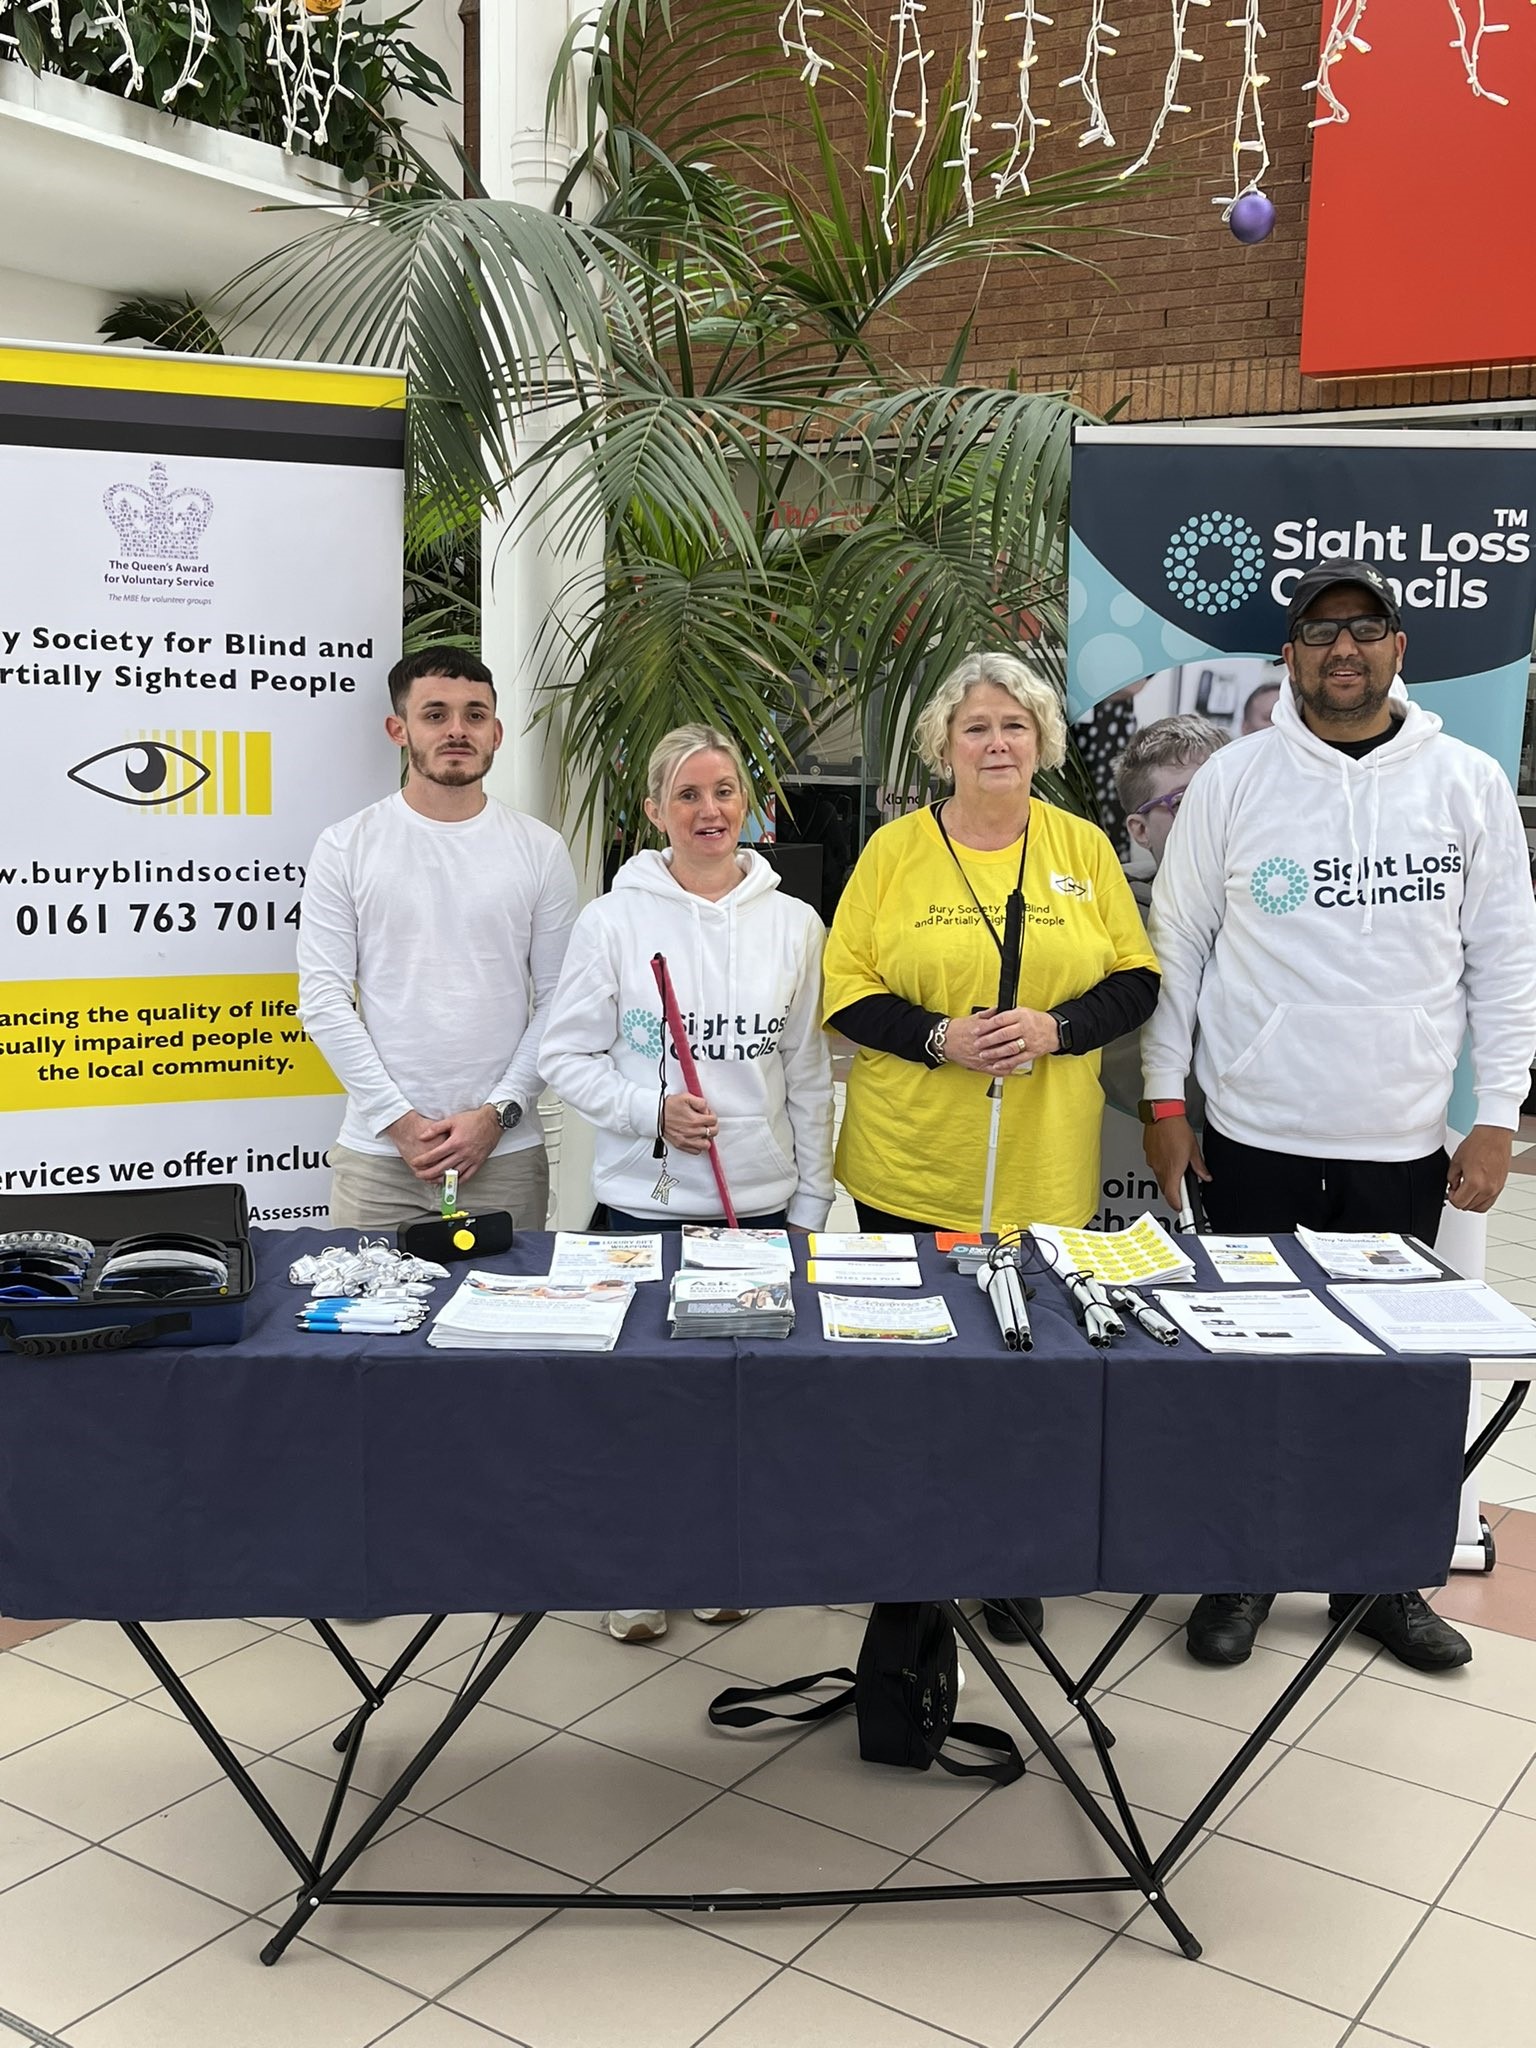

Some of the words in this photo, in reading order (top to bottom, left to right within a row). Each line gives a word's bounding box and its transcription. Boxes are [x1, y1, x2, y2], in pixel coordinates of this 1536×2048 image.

[1272, 517, 1408, 562] Sight
[1420, 523, 1530, 563] Loss
[1493, 508, 1528, 527] TM
[105, 574, 119, 583] for
[122, 575, 173, 587] Voluntary
[177, 577, 214, 587] Service
[110, 561, 128, 569] The
[132, 561, 172, 571] Queen's
[176, 564, 208, 573] Award
[108, 593, 122, 602] The
[123, 594, 140, 602] MBE
[141, 594, 151, 603] for
[152, 595, 186, 605] volunteer
[187, 598, 212, 606] groups
[1271, 566, 1488, 609] Cncils
[33, 627, 153, 658] Society
[164, 632, 211, 653] for
[226, 634, 305, 656] Blind
[319, 639, 372, 658] and
[0, 664, 101, 692] rtially
[116, 666, 236, 694] Sighted
[252, 670, 355, 697] People
[1313, 857, 1399, 886] Sight
[1405, 853, 1462, 875] Loss
[1314, 876, 1446, 908] Councils
[17, 904, 106, 935] 0161
[130, 903, 196, 932] 763
[214, 902, 301, 931] 7014
[914, 915, 934, 929] and
[935, 915, 982, 926] Partially
[1027, 914, 1066, 927] People
[928, 903, 955, 917] Bury
[957, 903, 1001, 915] Socety
[1024, 904, 1050, 914] Blind
[87, 1006, 128, 1022] the
[138, 1003, 221, 1024] quality
[230, 1001, 253, 1017] of
[262, 1000, 297, 1016] life
[753, 1013, 787, 1034] Los
[75, 1033, 183, 1055] impaired
[193, 1028, 272, 1051] people
[38, 1064, 79, 1080] the
[89, 1061, 143, 1078] local
[153, 1055, 293, 1075] community.
[0, 1162, 101, 1192] rvices
[109, 1162, 154, 1181] we
[164, 1151, 237, 1178] offer
[1102, 1170, 1159, 1200] oin
[651, 1173, 680, 1205] K
